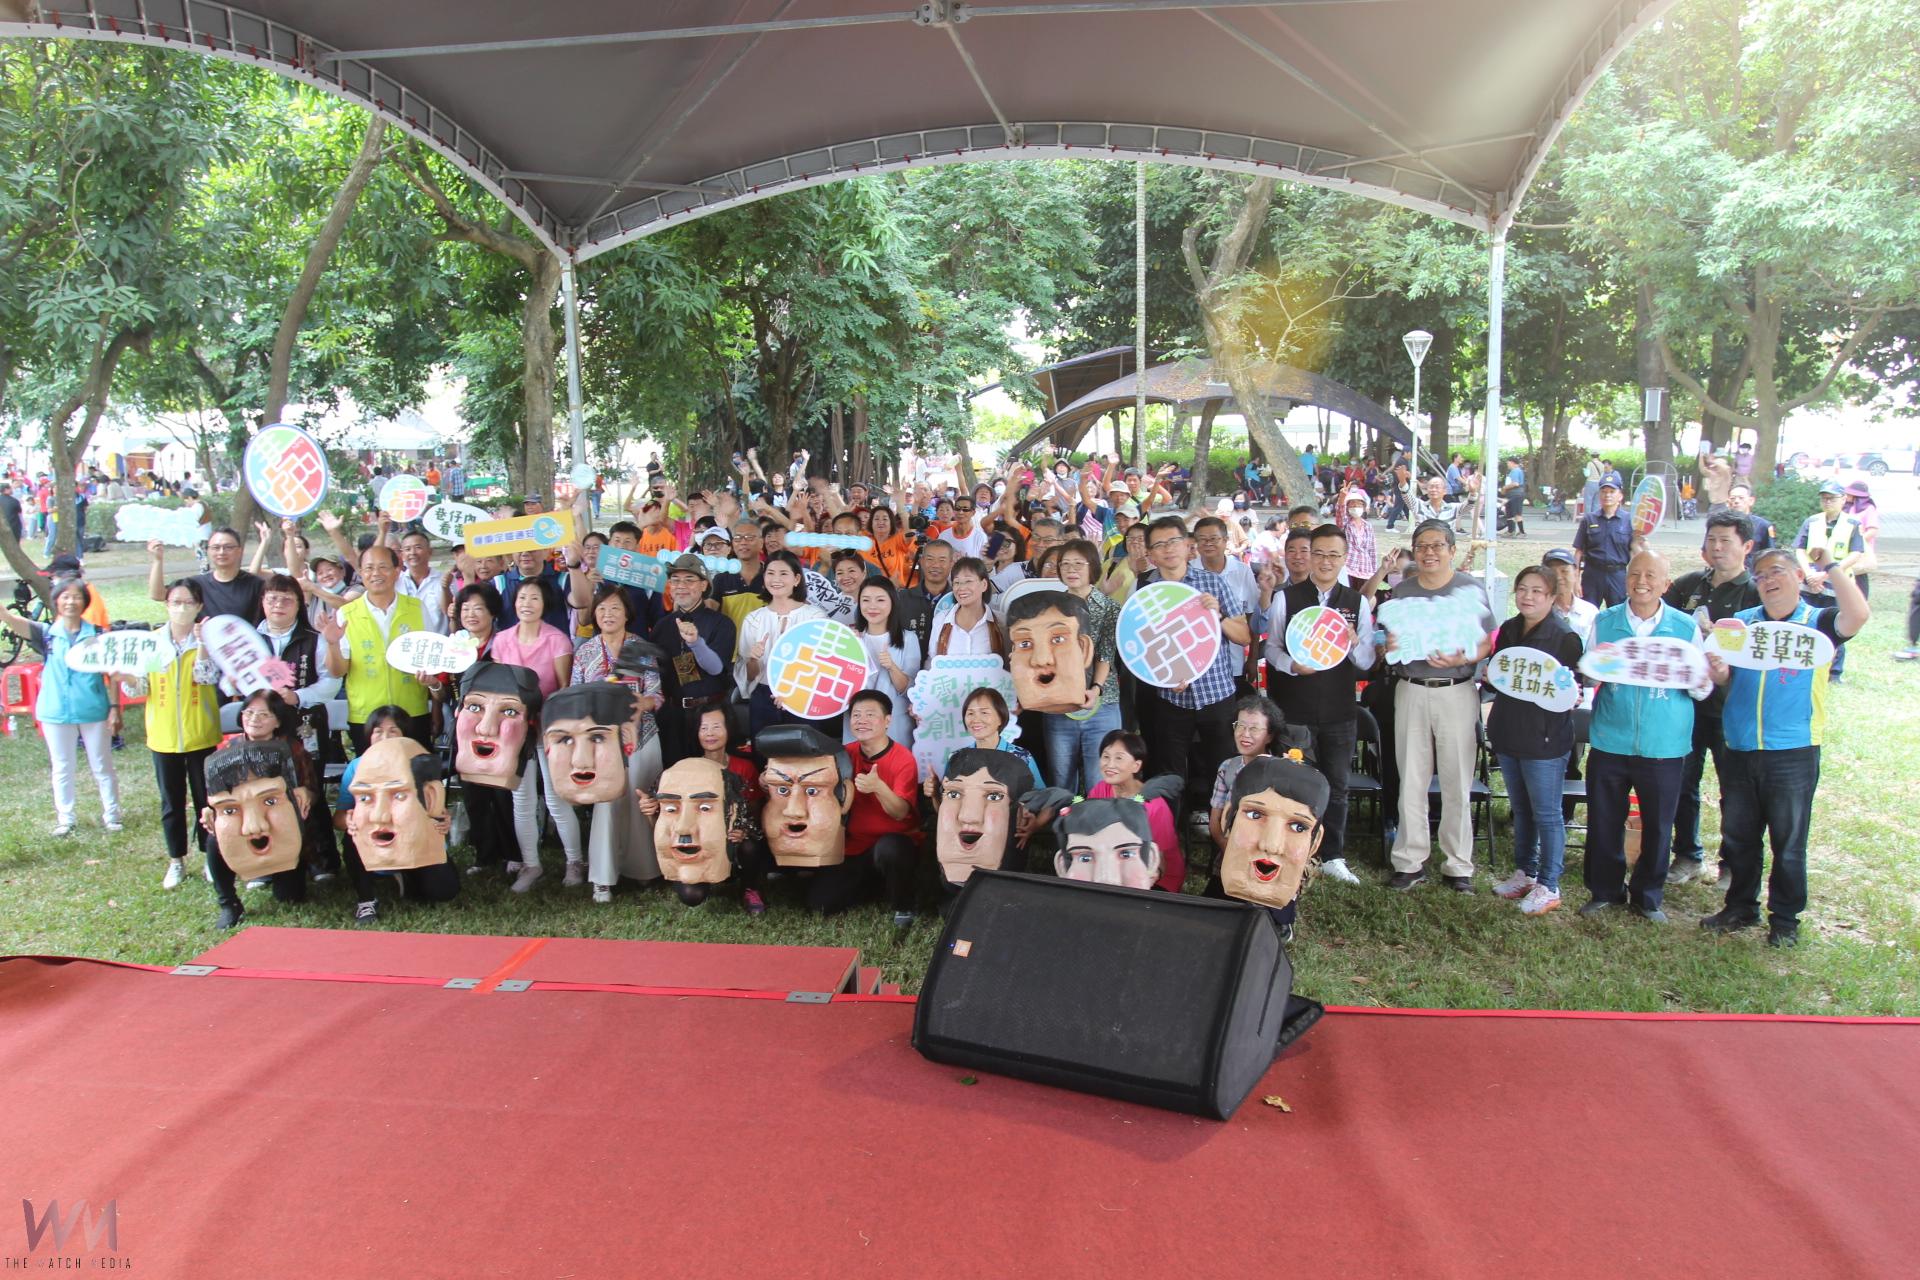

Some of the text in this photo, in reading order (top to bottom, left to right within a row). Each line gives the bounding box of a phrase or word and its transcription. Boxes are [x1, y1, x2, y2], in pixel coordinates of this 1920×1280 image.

[435, 508, 476, 523] 巷仔內
[401, 638, 444, 653] 巷仔內
[1751, 626, 1816, 650] 巷仔內
[1498, 655, 1542, 676] 巷仔內
[1750, 645, 1815, 666] 古早味
[1511, 674, 1556, 698] 真功夫
